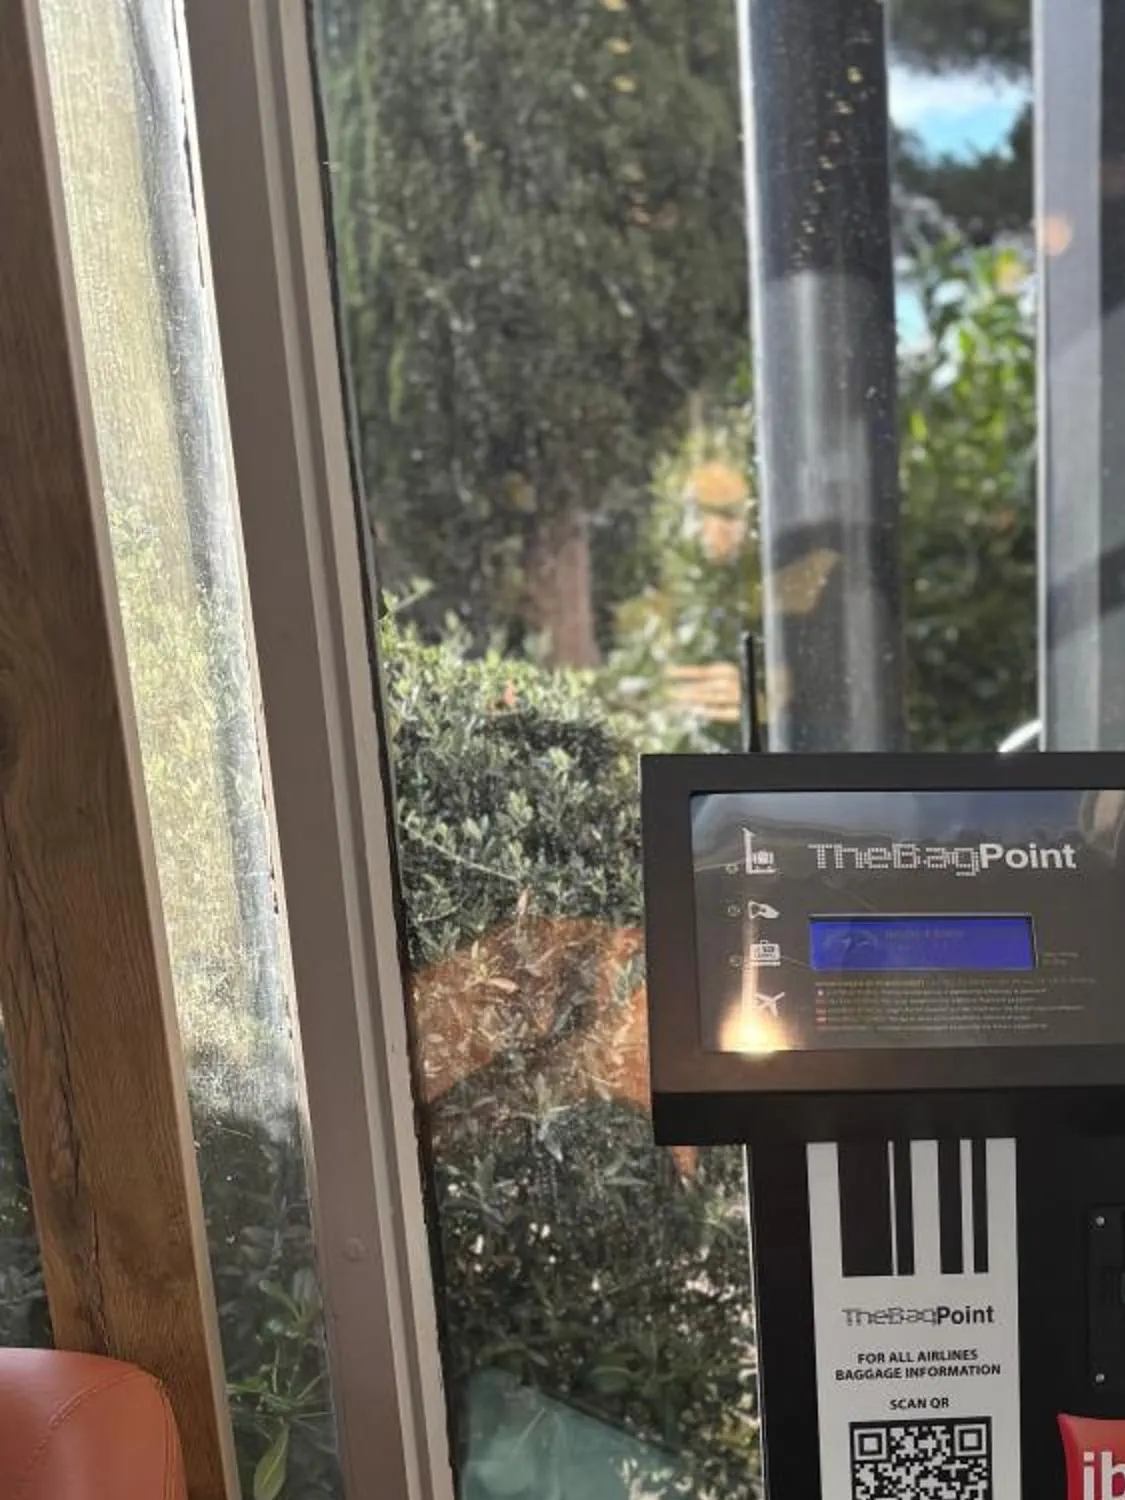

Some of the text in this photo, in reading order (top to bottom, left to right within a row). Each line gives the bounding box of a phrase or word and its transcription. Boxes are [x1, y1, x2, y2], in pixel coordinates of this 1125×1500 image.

[807, 842, 1078, 877] TheBagPoint
[841, 1305, 995, 1326] TheBagPoint
[857, 1349, 978, 1364] FOR ALL AIRLINES
[835, 1364, 1001, 1380] BAGGAGE INFORMATION
[889, 1397, 950, 1410] SCAN QR
